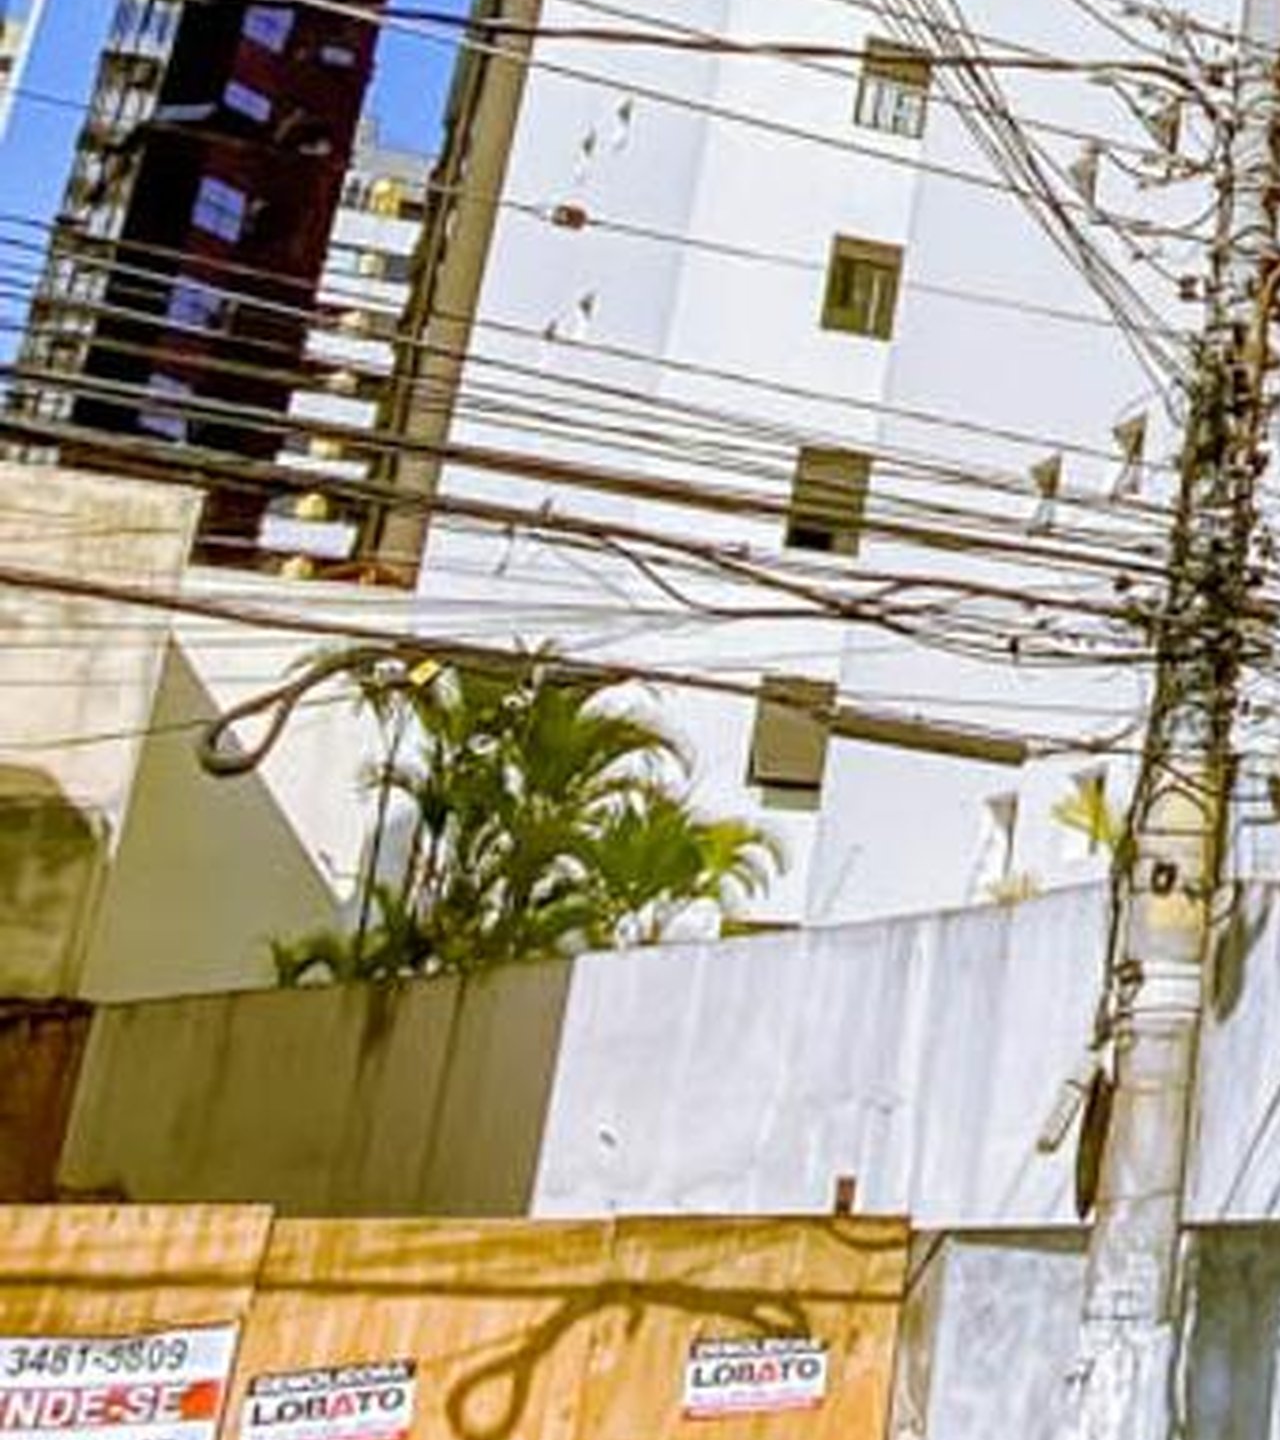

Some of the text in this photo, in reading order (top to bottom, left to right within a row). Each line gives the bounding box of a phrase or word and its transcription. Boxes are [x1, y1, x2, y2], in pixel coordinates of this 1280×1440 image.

[693, 1359, 821, 1388] LOBATO
[0, 1382, 182, 1428] NDE-SE
[252, 1387, 405, 1426] LOBATO
